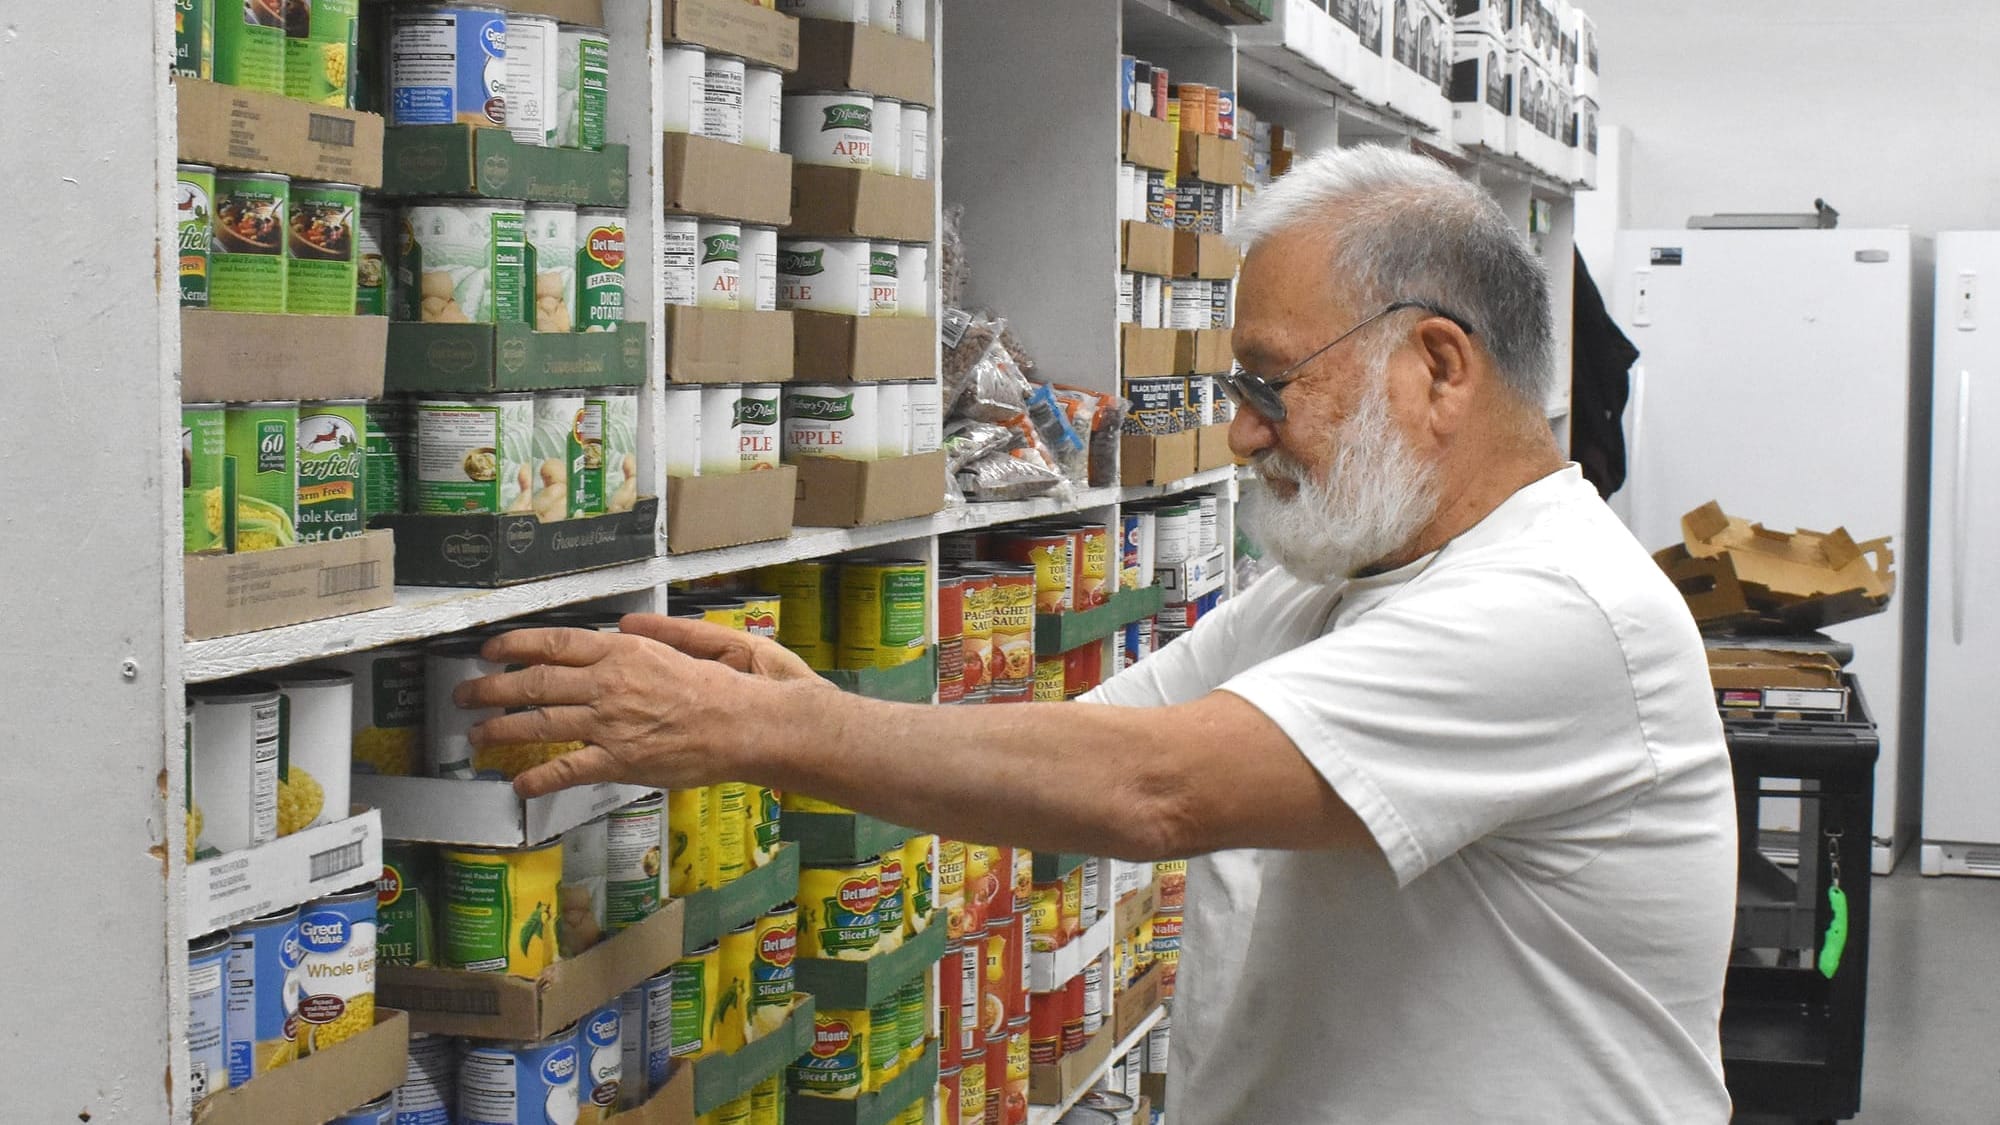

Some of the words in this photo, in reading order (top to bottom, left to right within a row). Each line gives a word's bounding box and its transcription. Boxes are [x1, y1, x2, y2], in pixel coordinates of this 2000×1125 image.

[261, 433, 284, 453] 60
[323, 484, 347, 497] Fresh
[325, 508, 358, 522] Kernel
[842, 889, 857, 901] Del
[301, 921, 343, 937] Great
[838, 929, 867, 941] Sliced
[311, 935, 343, 945] Value
[307, 959, 355, 978] Whole
[758, 982, 786, 996] Sliced
[817, 1030, 849, 1042] Monte
[807, 1058, 841, 1069] Lite
[799, 1071, 828, 1082] Sliced
[831, 1071, 857, 1083] Pears
